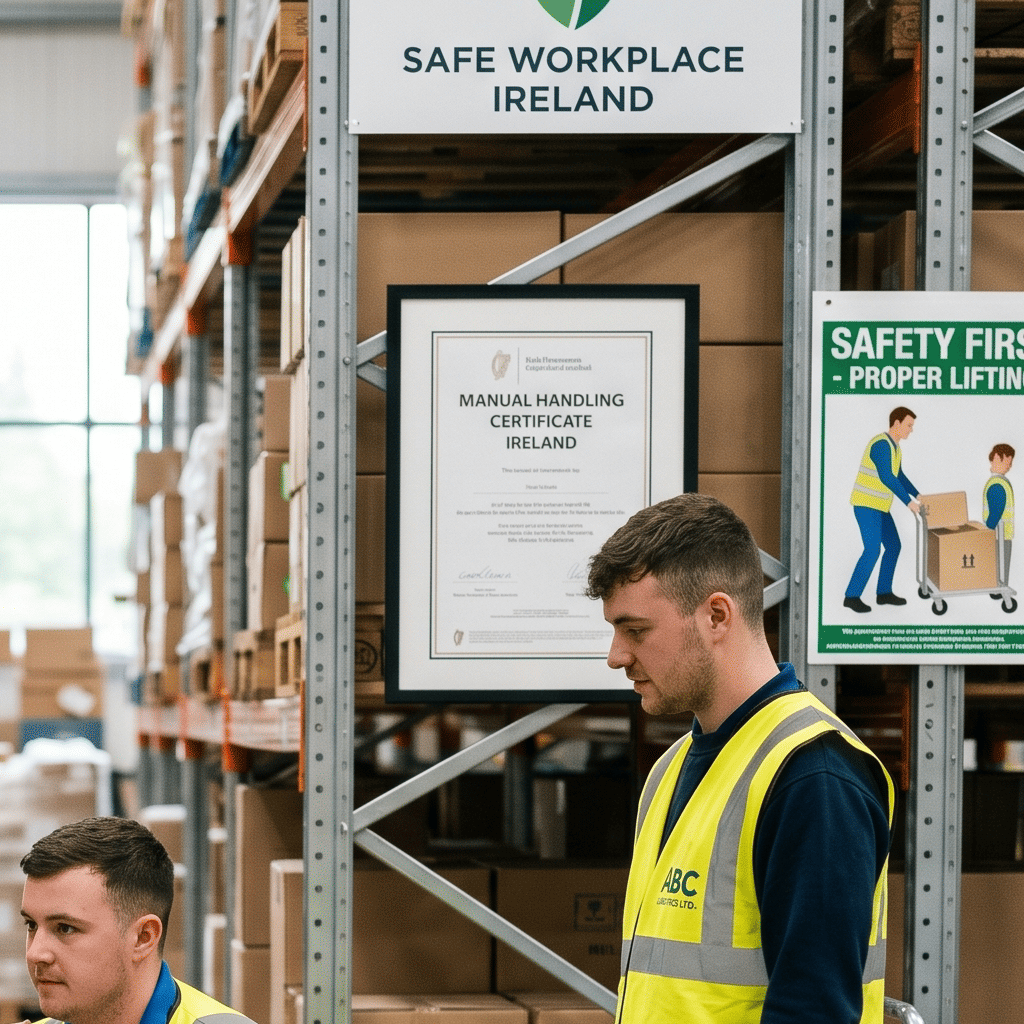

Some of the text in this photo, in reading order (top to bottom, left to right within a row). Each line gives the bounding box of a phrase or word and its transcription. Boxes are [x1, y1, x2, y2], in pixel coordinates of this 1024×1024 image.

[403, 46, 744, 73] SAFE WORKPLACE
[494, 86, 654, 112] IRELAND
[831, 327, 956, 359] SAFETY
[849, 366, 942, 389] PROPER
[459, 393, 625, 408] MANUAL HANDLING
[490, 414, 593, 428] CERTIFICATE
[506, 436, 577, 449] IRELAND
[660, 866, 700, 897] ABC
